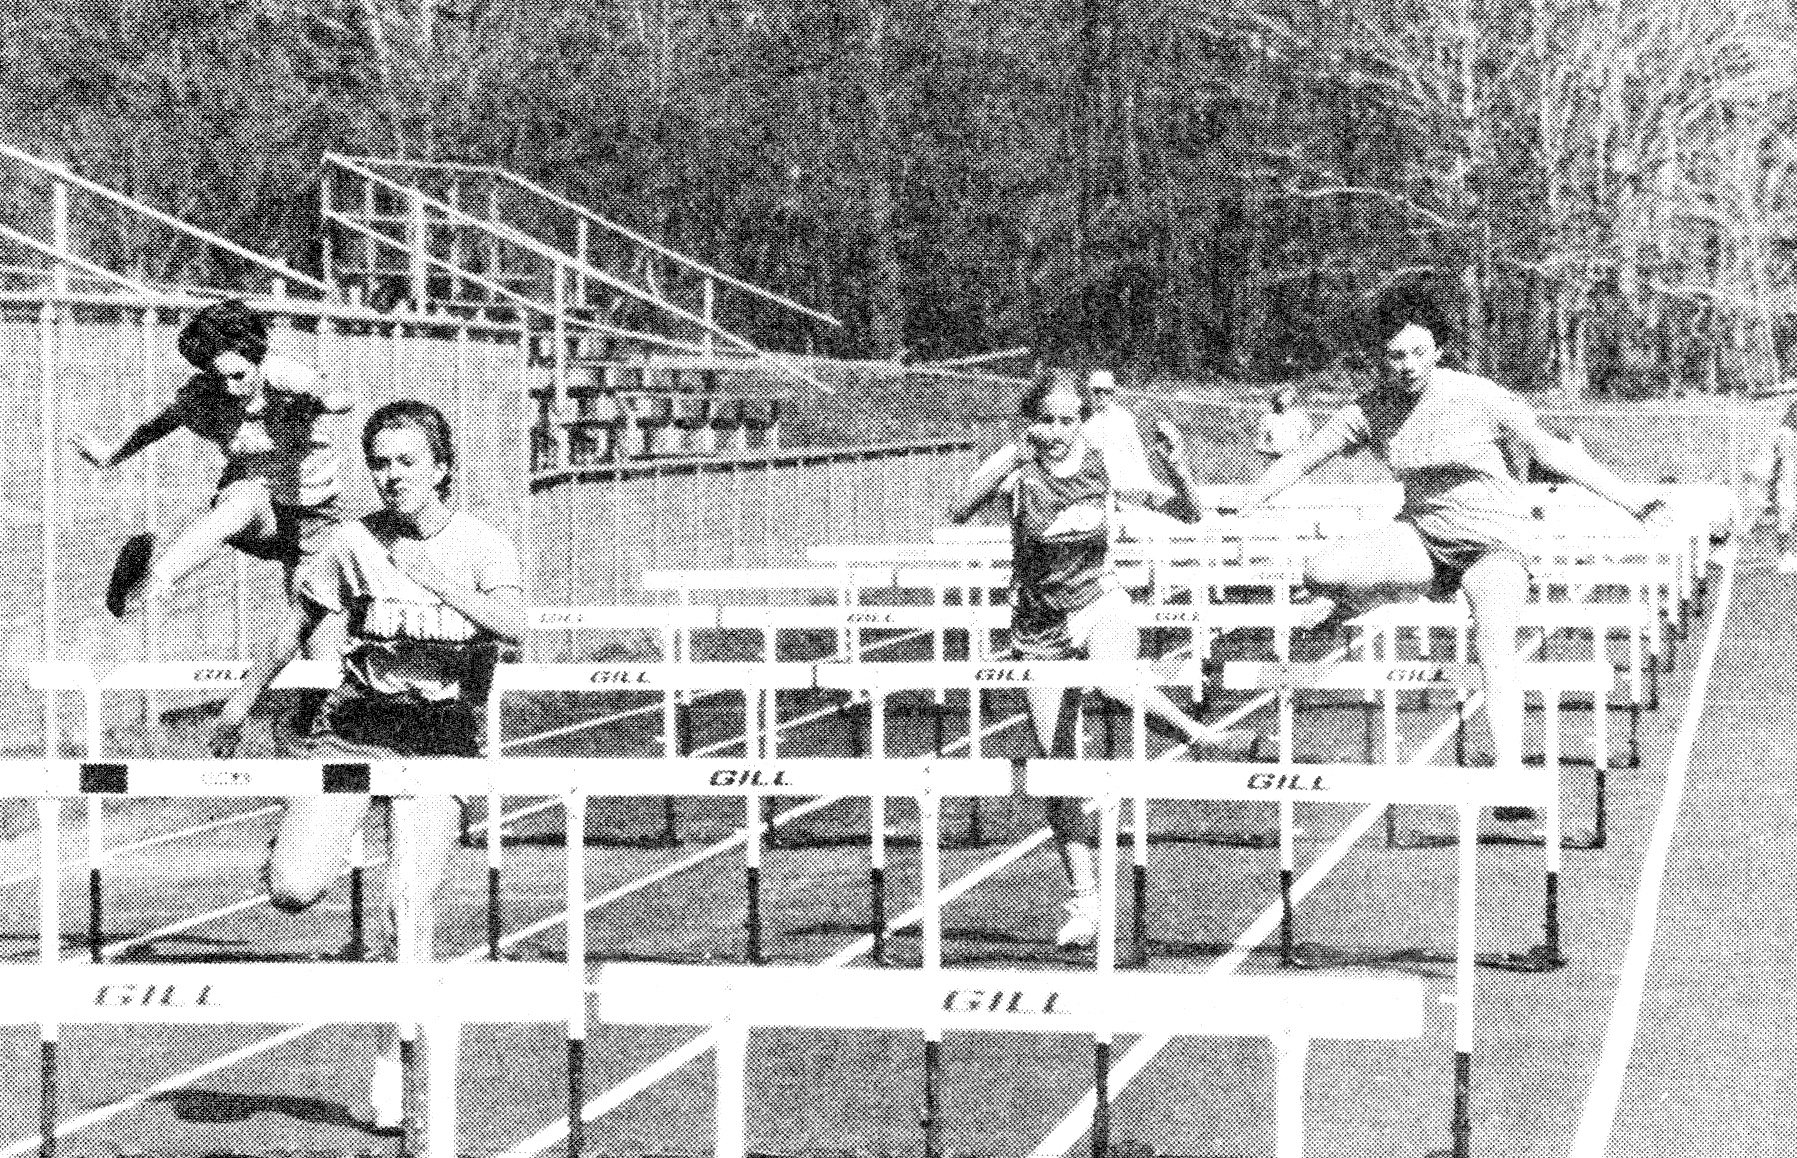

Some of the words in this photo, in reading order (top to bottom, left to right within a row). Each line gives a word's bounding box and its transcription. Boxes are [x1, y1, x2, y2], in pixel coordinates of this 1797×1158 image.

[590, 670, 651, 684] GILL
[975, 668, 1036, 682] GILL
[709, 769, 793, 788] GILL
[1247, 773, 1331, 791] GILL
[92, 983, 222, 1008] GILL
[941, 989, 1073, 1015] GILL
